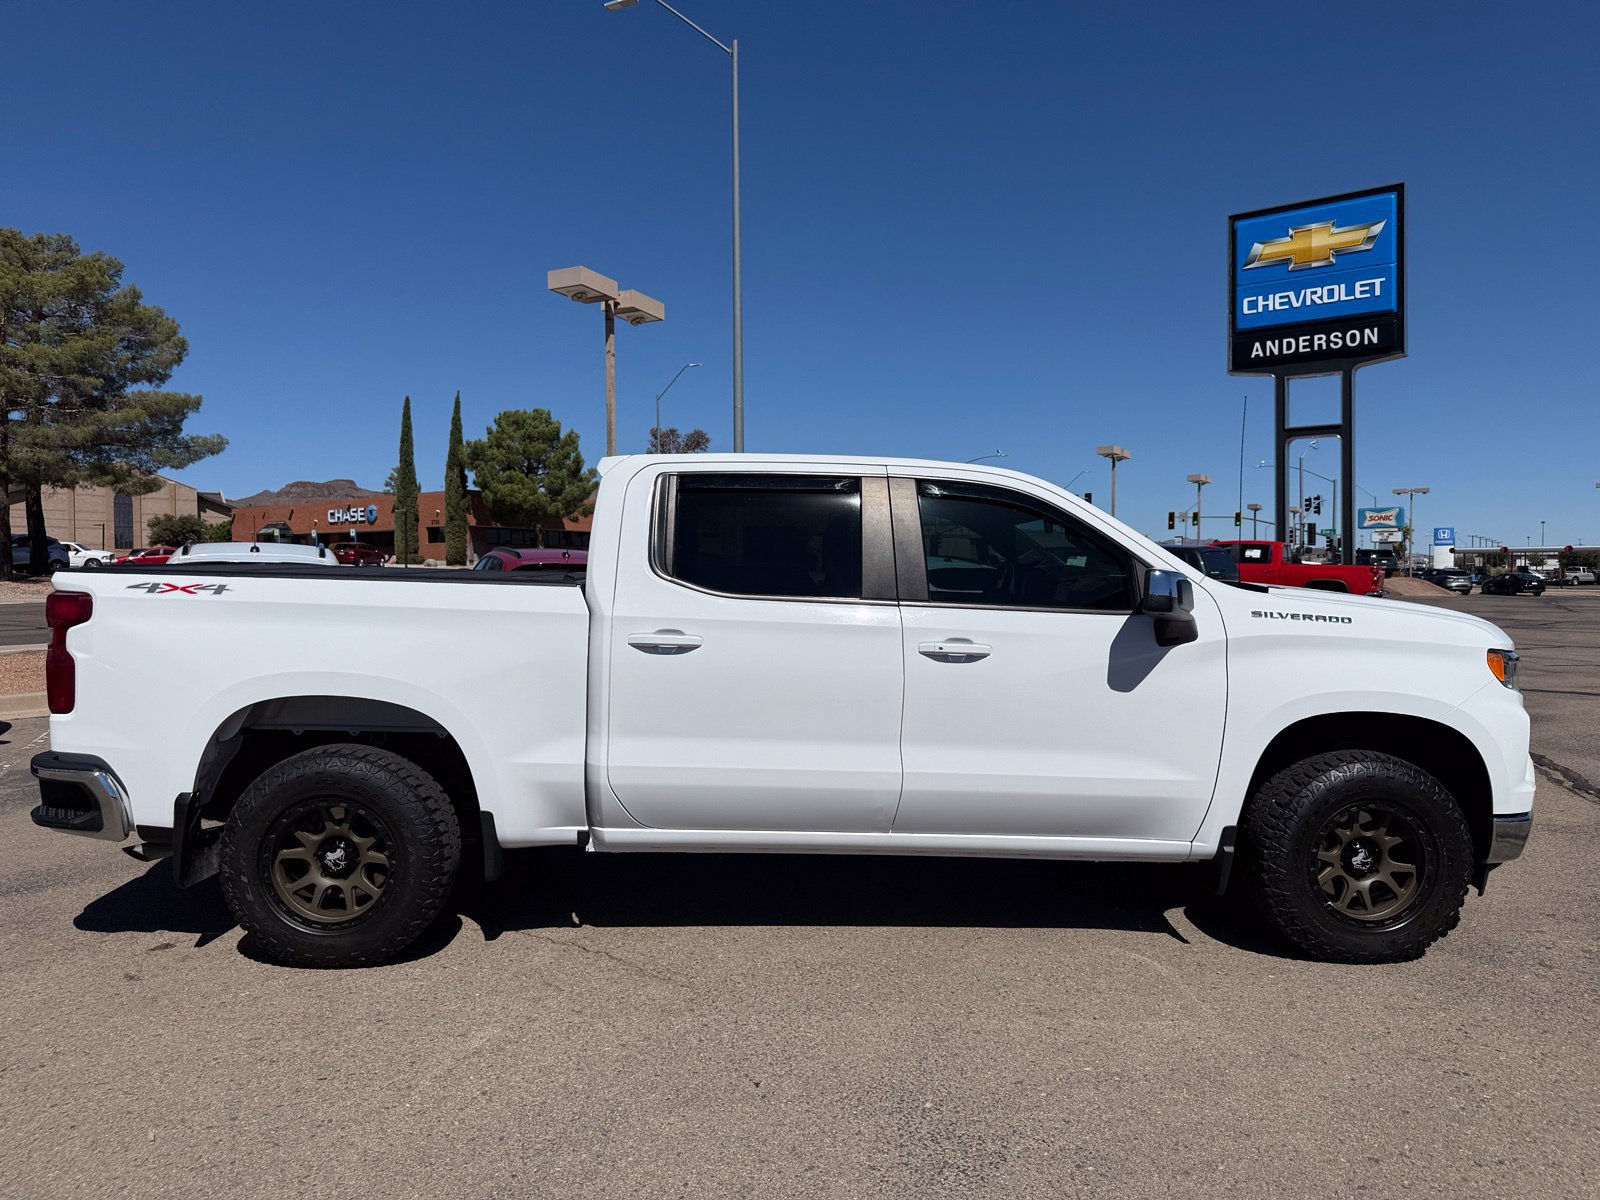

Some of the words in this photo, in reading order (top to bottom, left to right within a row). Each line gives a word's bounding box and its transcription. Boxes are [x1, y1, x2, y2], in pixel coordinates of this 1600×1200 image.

[1242, 277, 1386, 315] CHEVROLET
[1250, 327, 1379, 359] ANDERSON
[327, 507, 366, 523] CHASE
[1368, 514, 1393, 522] SONIC
[1251, 610, 1353, 625] SILVERADO
